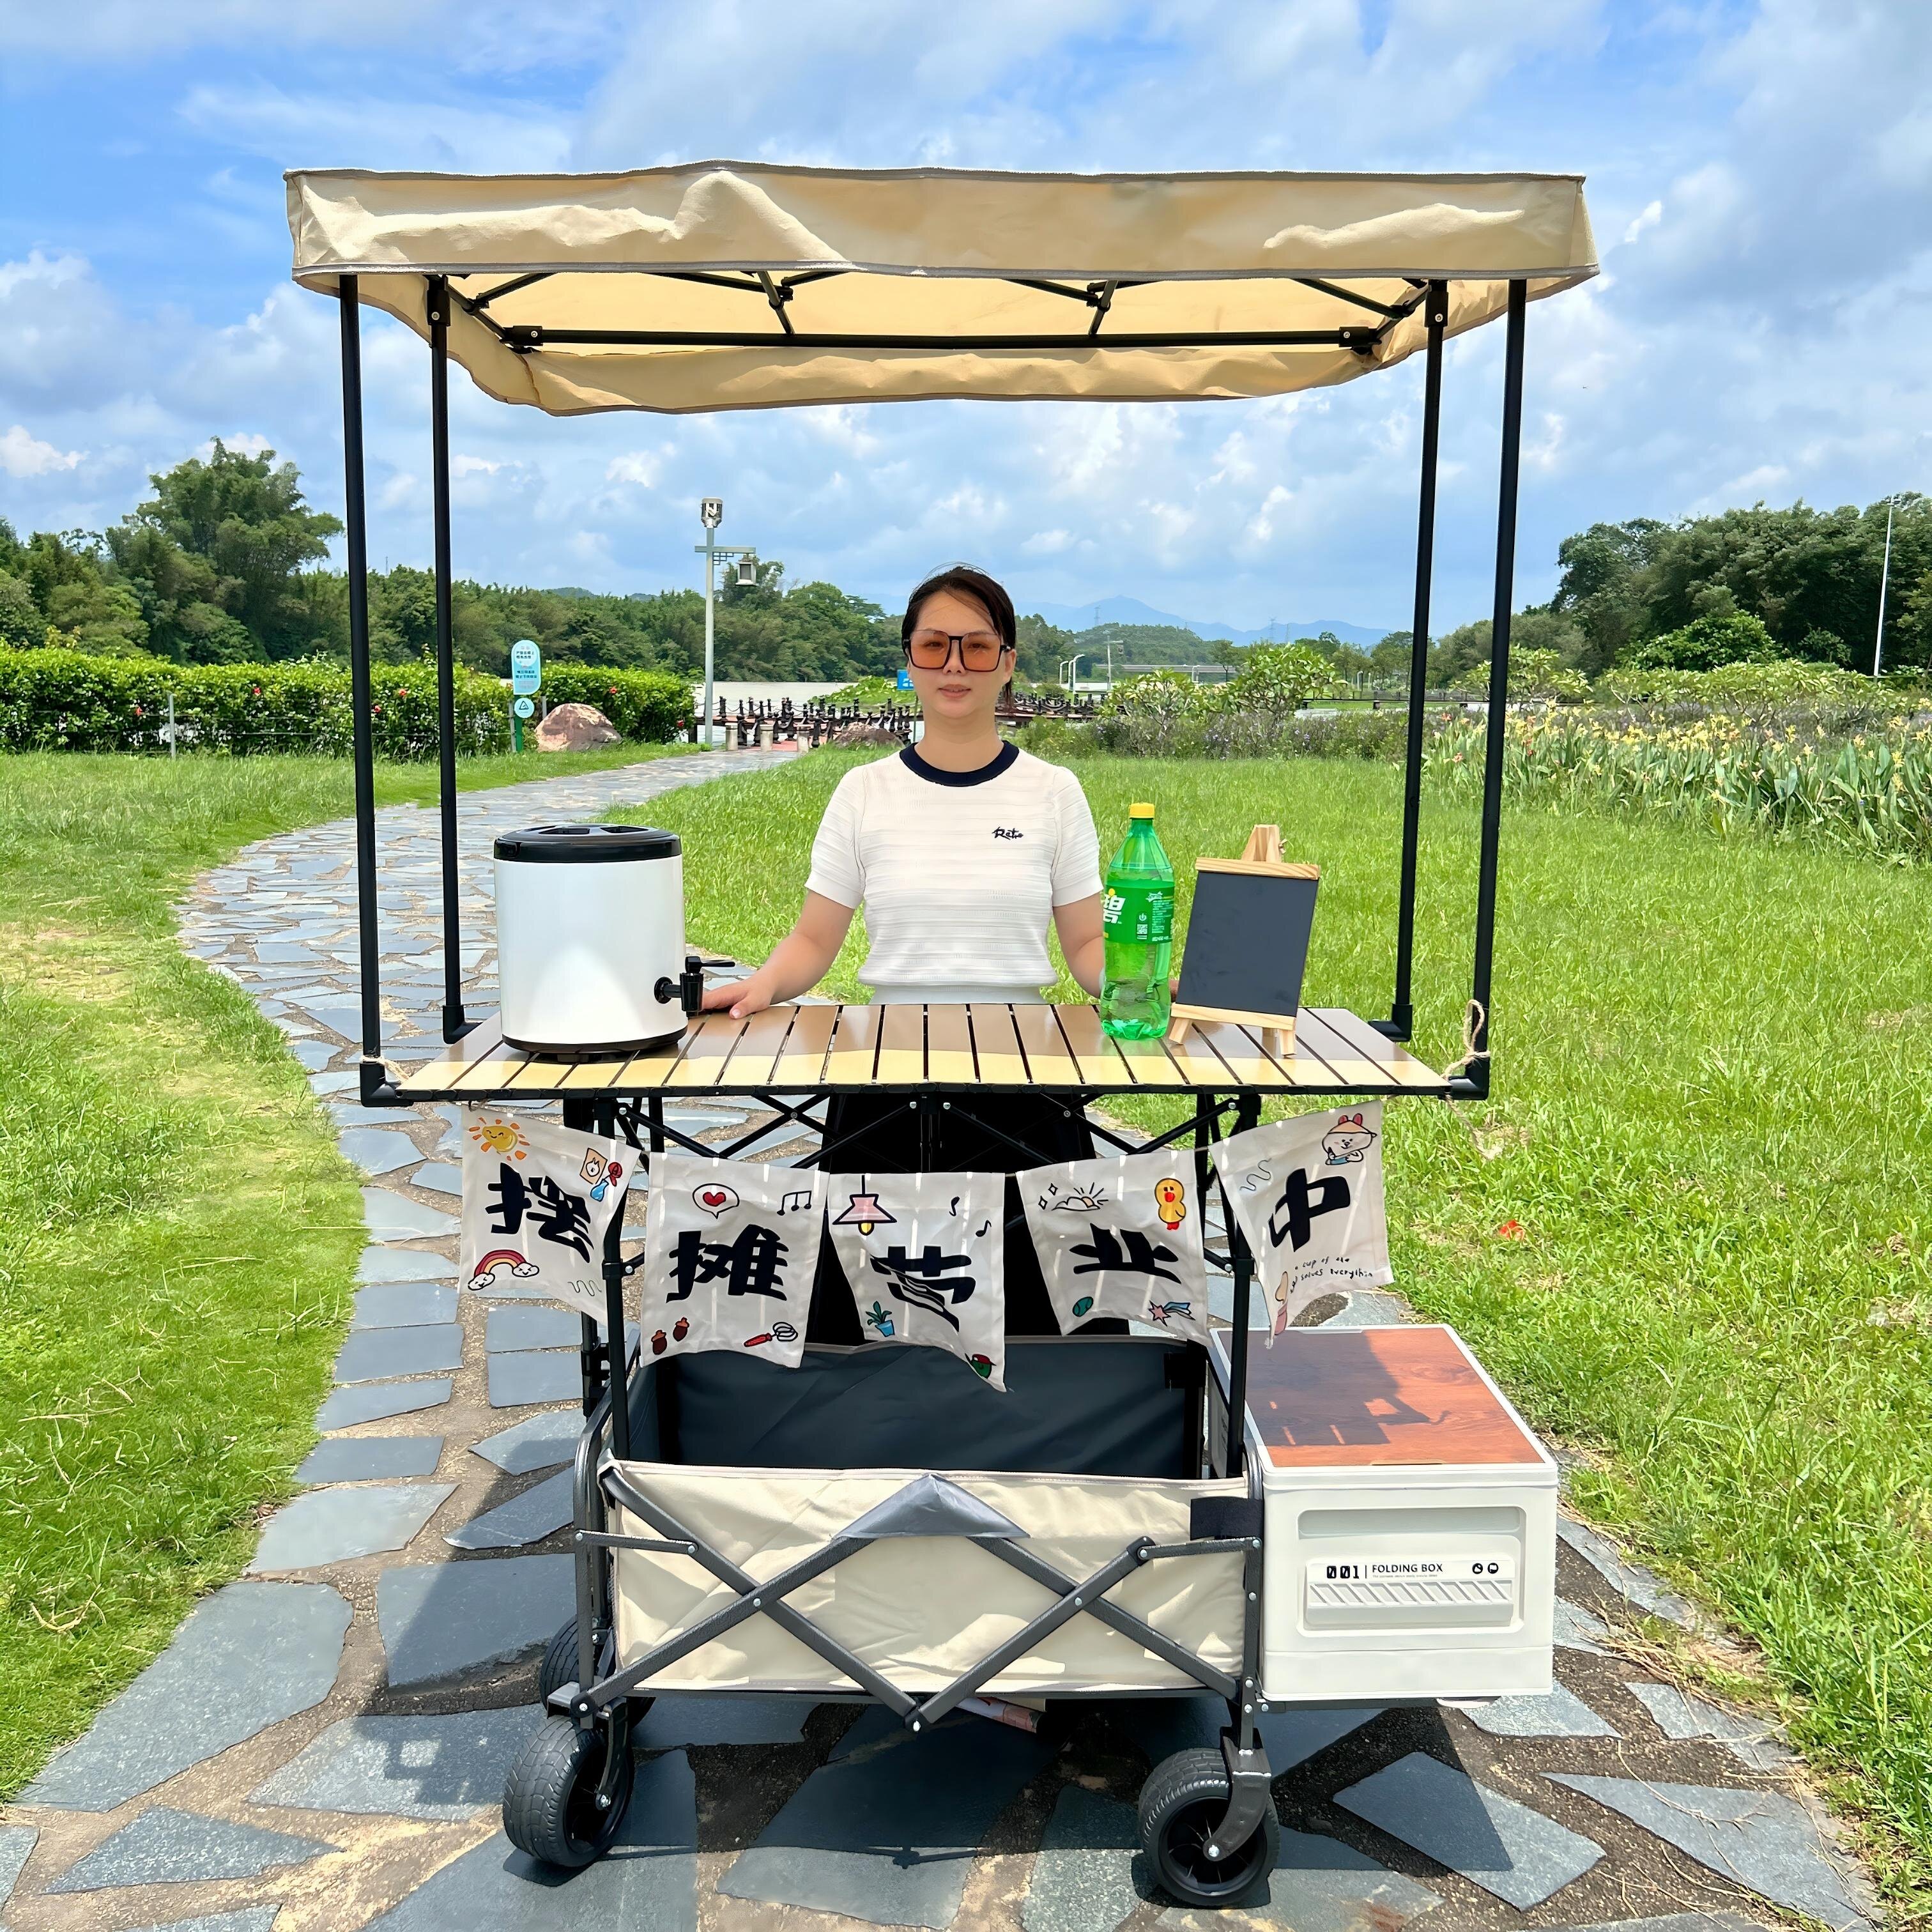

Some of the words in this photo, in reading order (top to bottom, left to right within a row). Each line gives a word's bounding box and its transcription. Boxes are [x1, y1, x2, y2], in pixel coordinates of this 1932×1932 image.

[485, 1162, 594, 1263] 摆
[1268, 1168, 1351, 1251] 中
[666, 1223, 788, 1303] 摊
[1070, 1223, 1181, 1284] 业
[1303, 1260, 1317, 1269] cup
[1372, 1564, 1418, 1573] FOLDING
[1422, 1563, 1443, 1572] BOX
